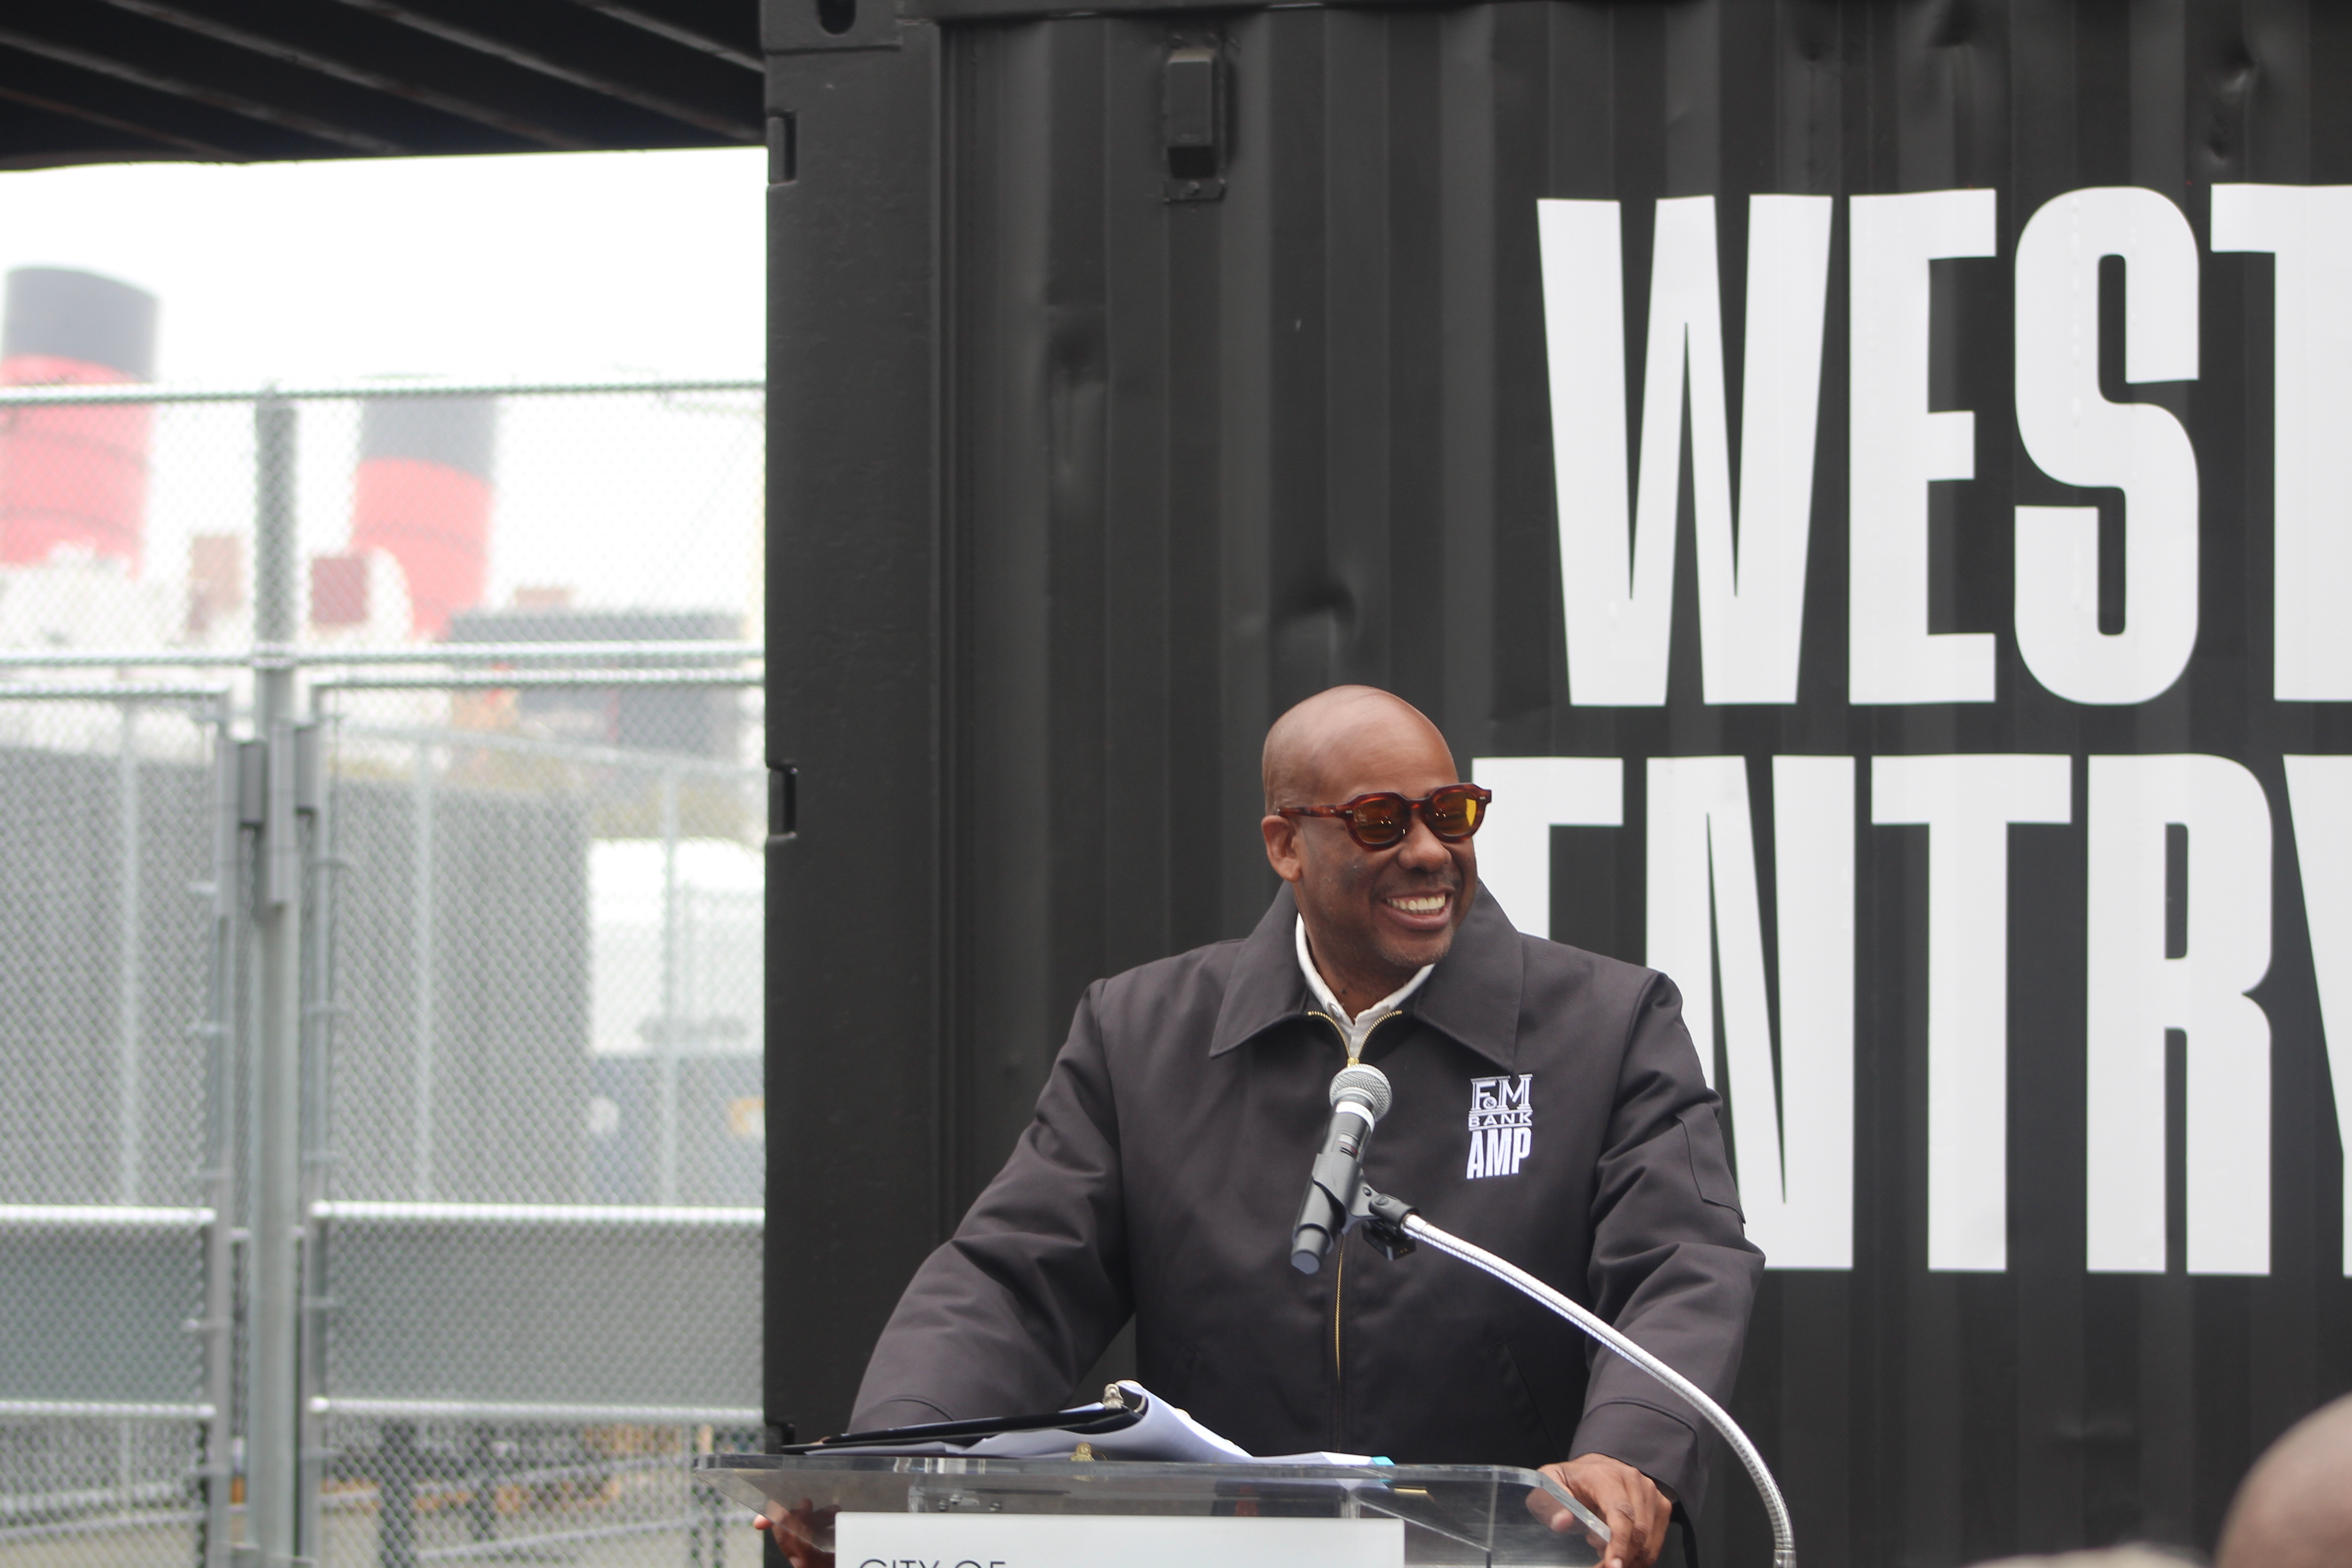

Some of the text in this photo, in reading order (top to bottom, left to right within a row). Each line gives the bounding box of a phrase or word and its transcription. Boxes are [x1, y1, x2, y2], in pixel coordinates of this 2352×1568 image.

[1537, 184, 2352, 706] WEST
[1469, 1111, 1533, 1128] BANK
[1466, 1127, 1532, 1179] AMP
